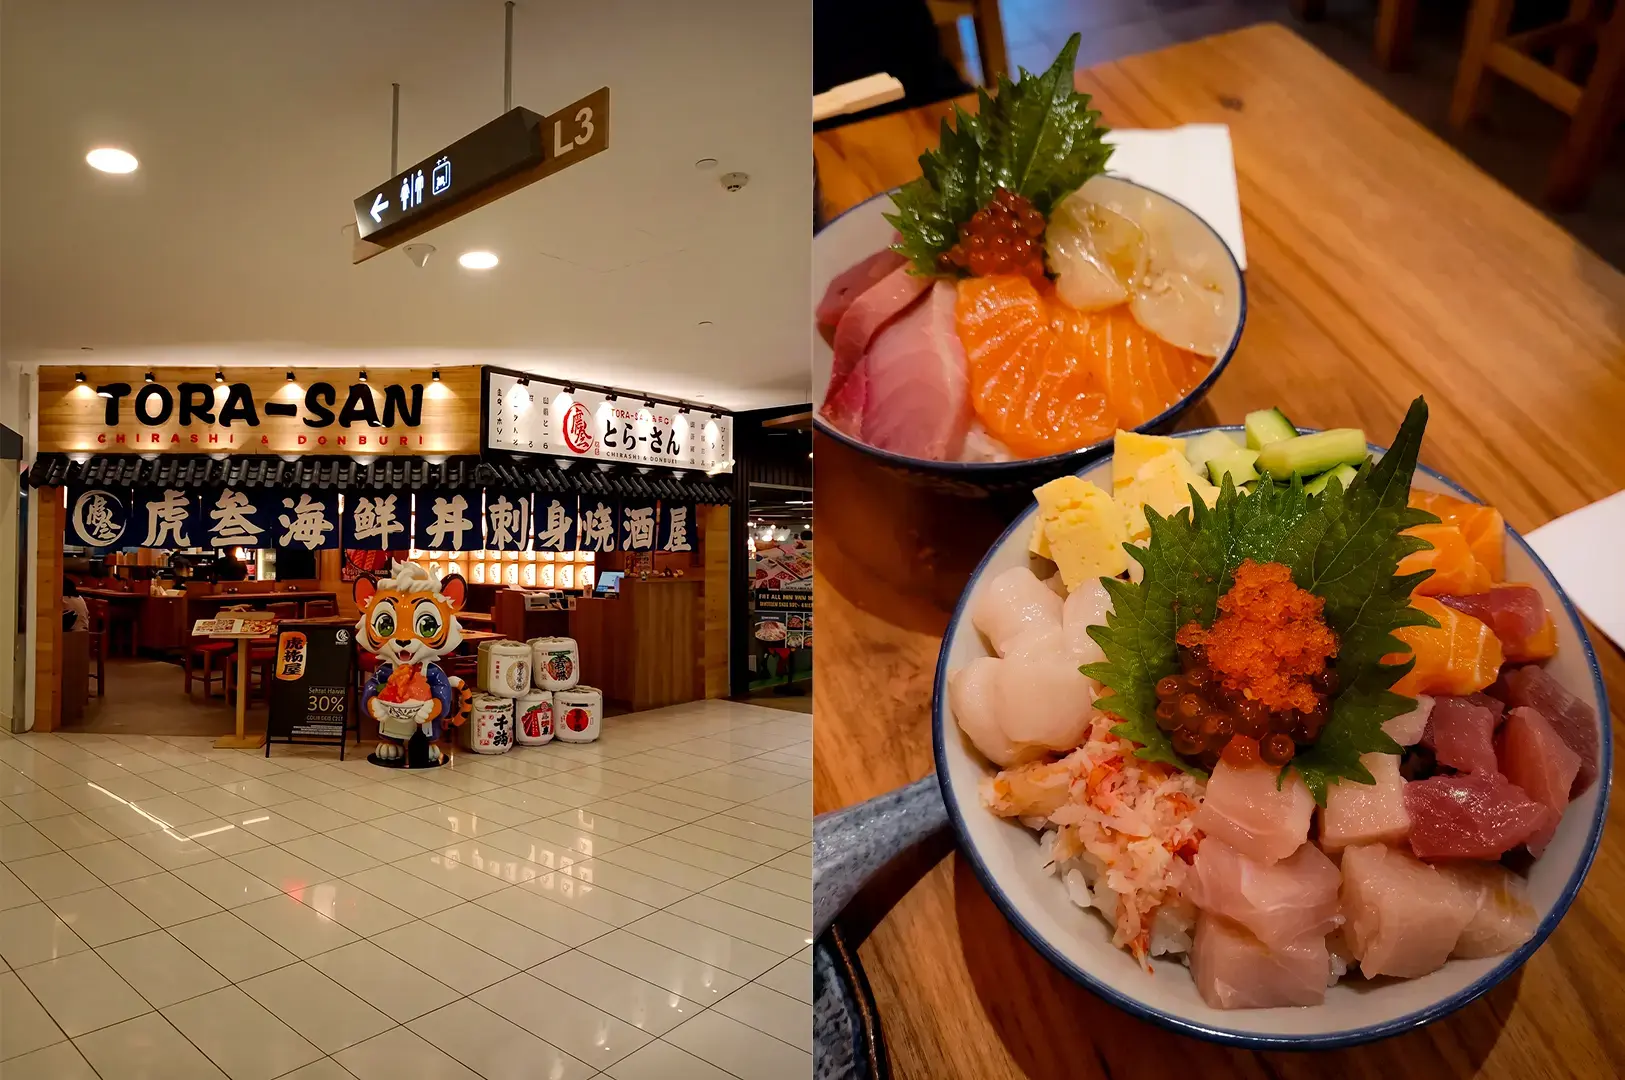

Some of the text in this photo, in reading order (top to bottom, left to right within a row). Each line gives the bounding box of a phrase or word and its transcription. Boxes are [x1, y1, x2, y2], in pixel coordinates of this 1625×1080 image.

[553, 106, 595, 158] L3
[96, 381, 424, 428] TORA-SAN
[97, 433, 424, 446] CHIRASHI & DONBURI
[603, 419, 681, 456] とらーさん
[606, 451, 640, 461] CHIRASHI
[307, 695, 344, 713] 30%
